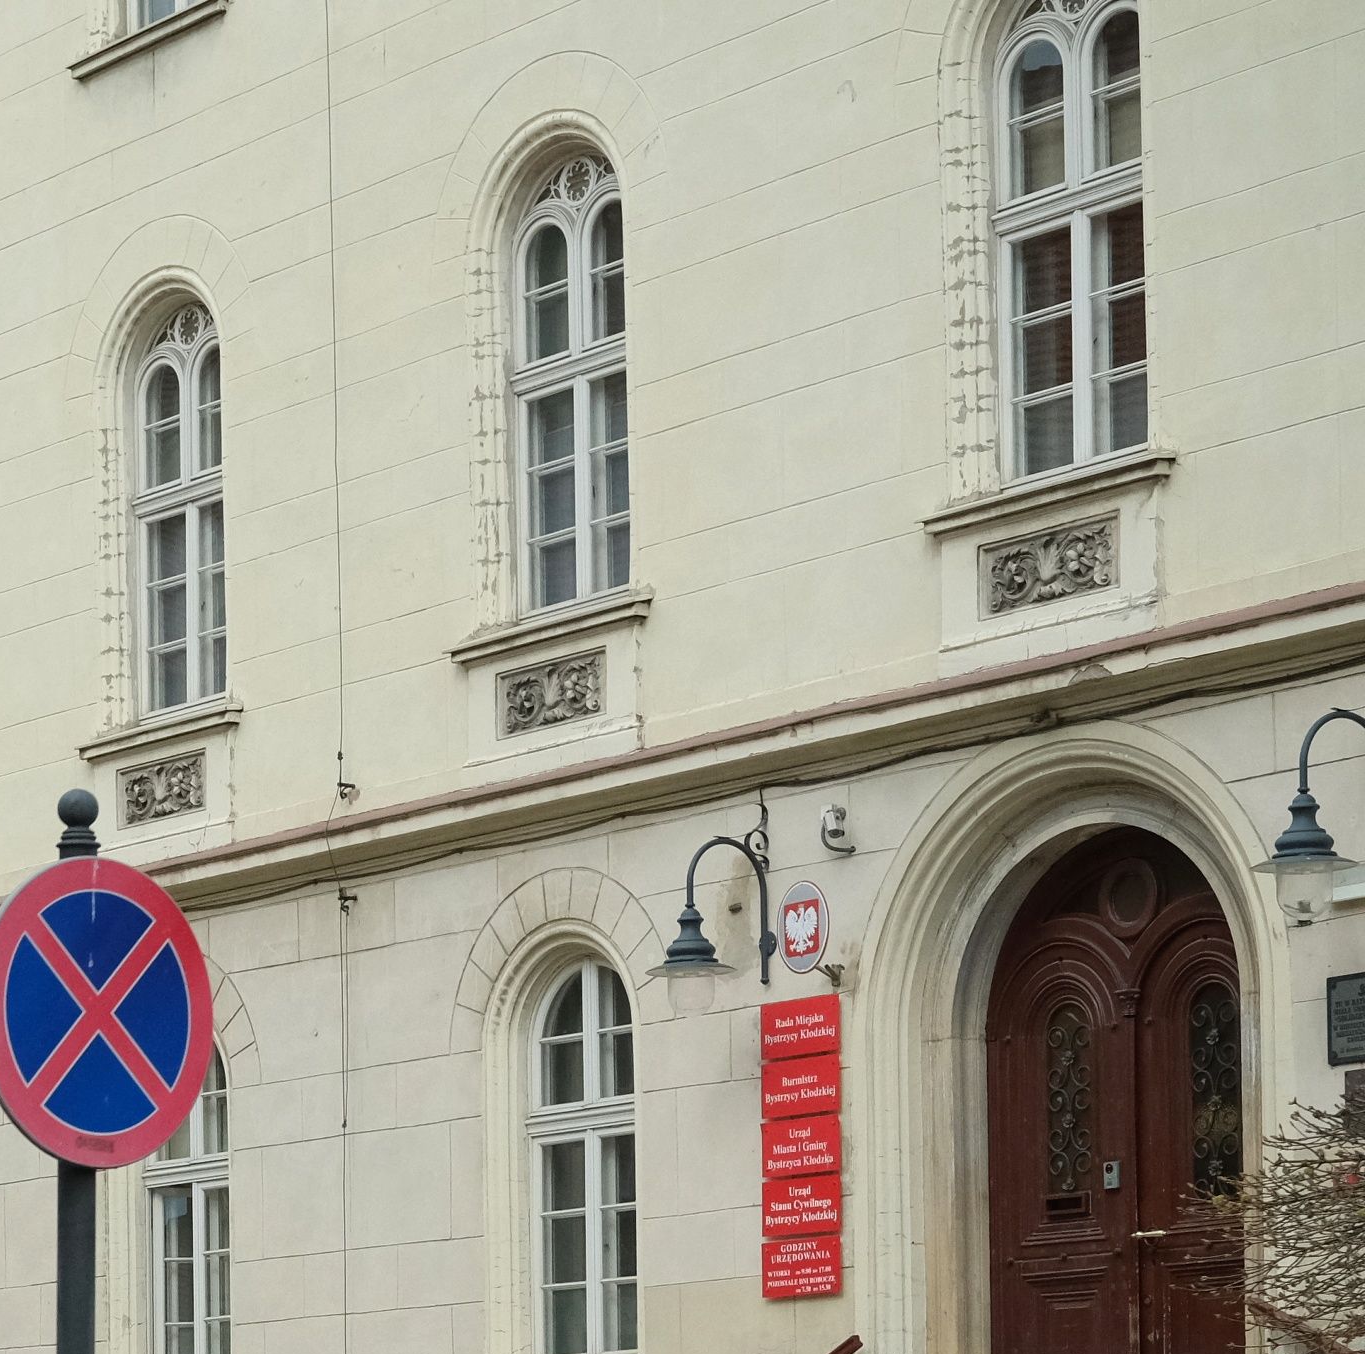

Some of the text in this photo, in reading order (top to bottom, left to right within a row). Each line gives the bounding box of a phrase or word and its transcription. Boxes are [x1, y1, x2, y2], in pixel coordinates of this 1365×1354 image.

[775, 1013, 824, 1029] Rada Miejska
[764, 1025, 836, 1046] Bystrzycy Kłodzkiej
[782, 1074, 818, 1087] Burmistrz
[765, 1085, 836, 1105] Bystrzycy Kłodzkiej
[789, 1126, 811, 1139] Urząd
[772, 1144, 797, 1155] Miasta
[802, 1140, 828, 1152] Gminy
[767, 1153, 834, 1171] Bystrzyca Kłodzka
[788, 1185, 812, 1198] Urząd
[770, 1197, 832, 1212] Stanu Cywilnego
[765, 1209, 838, 1228] Bystrzycy Kłodzkiej
[780, 1241, 818, 1253] GODZINY
[770, 1250, 831, 1264] URZĘDOWANIA
